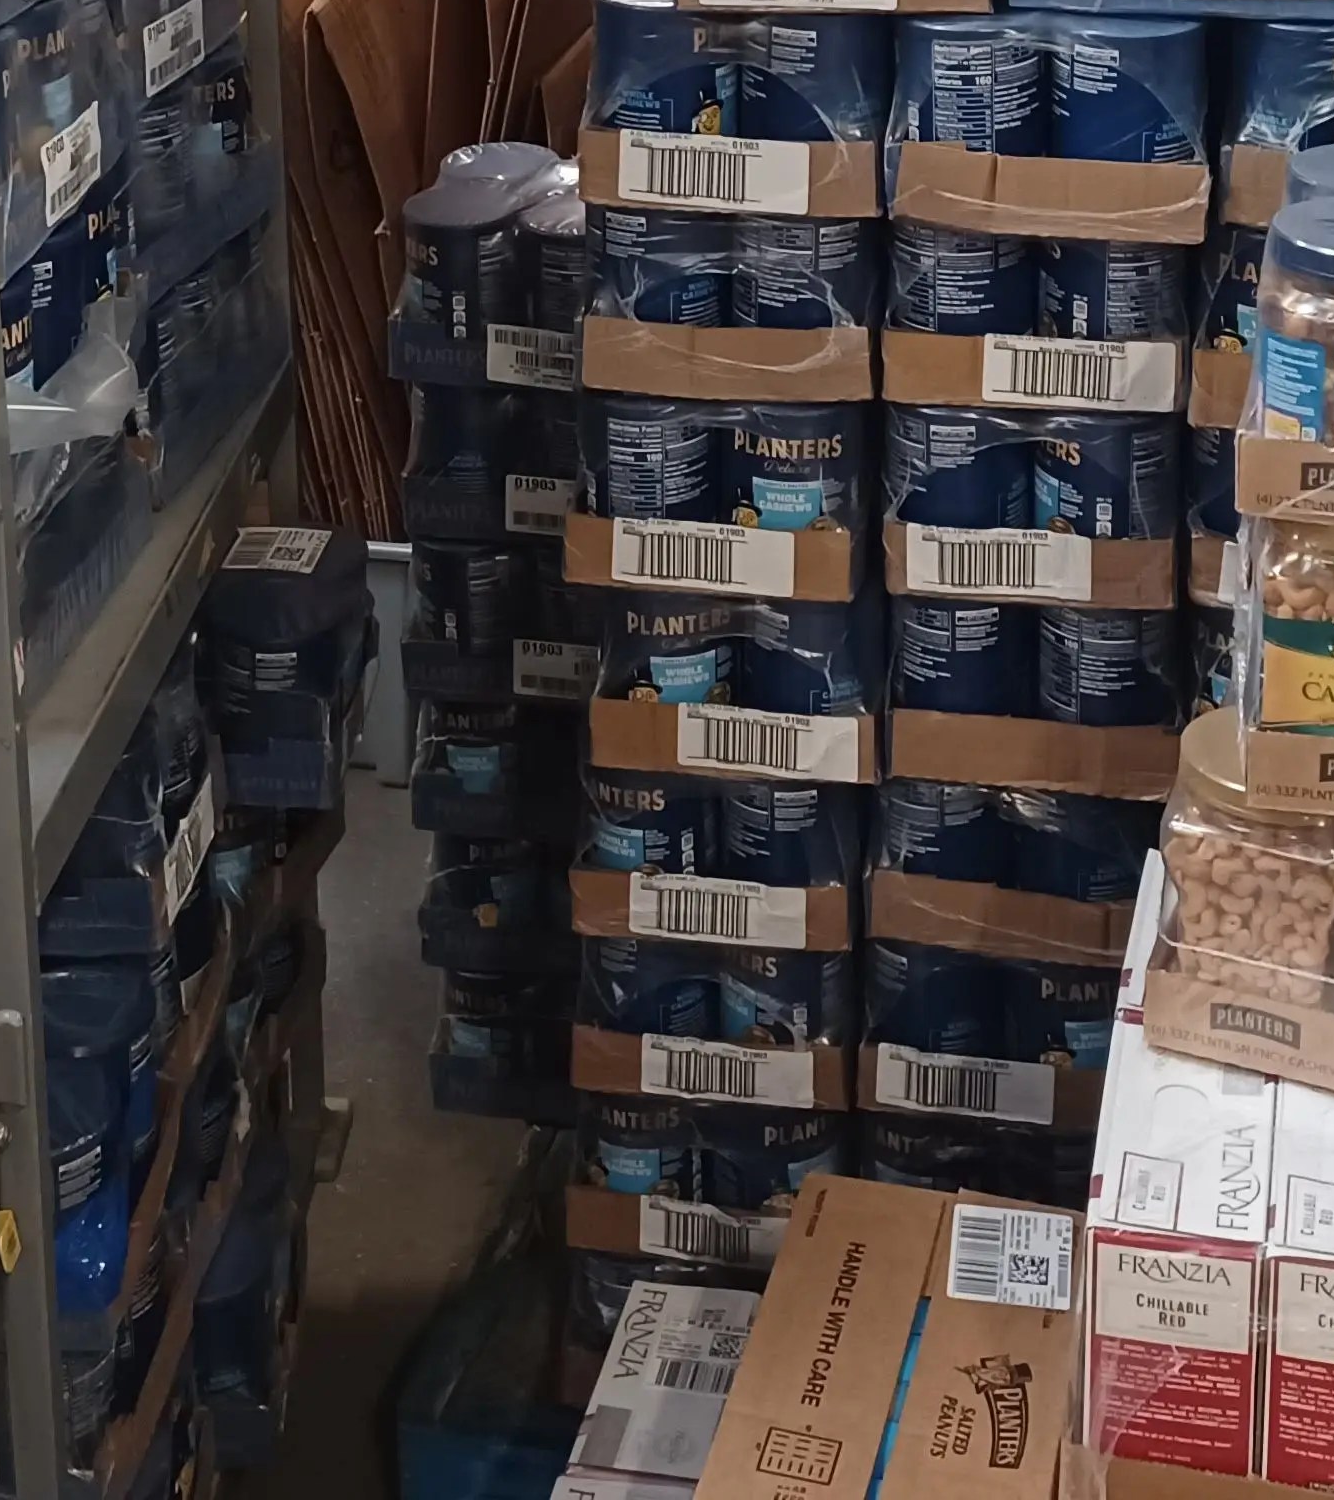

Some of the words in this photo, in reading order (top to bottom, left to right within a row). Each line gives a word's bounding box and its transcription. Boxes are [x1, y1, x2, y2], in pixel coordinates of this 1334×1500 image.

[731, 139, 759, 151] 01903
[1099, 343, 1126, 353] 01903
[734, 428, 843, 459] PLANTERS
[515, 477, 557, 492] 01903
[765, 491, 809, 504] WHOLE
[719, 527, 746, 538] 01903
[1021, 531, 1048, 541] 01903
[522, 641, 562, 656] 01903
[665, 667, 705, 682] WHOLE
[1216, 1008, 1295, 1042] PLANTERS
[1215, 1123, 1260, 1233] FRANZIA
[831, 1241, 866, 1308] HANDLE
[1118, 1252, 1231, 1287] FRANZIA
[1136, 1293, 1209, 1317] CHILLABLE
[1158, 1311, 1187, 1329] RED
[612, 1287, 668, 1380] FRANZIA
[817, 1304, 851, 1356] WITH
[800, 1355, 831, 1408] CARE
[929, 1395, 957, 1459] PEANUTS
[953, 1407, 976, 1457] SALTED
[992, 1387, 1027, 1466] PLANTERS
